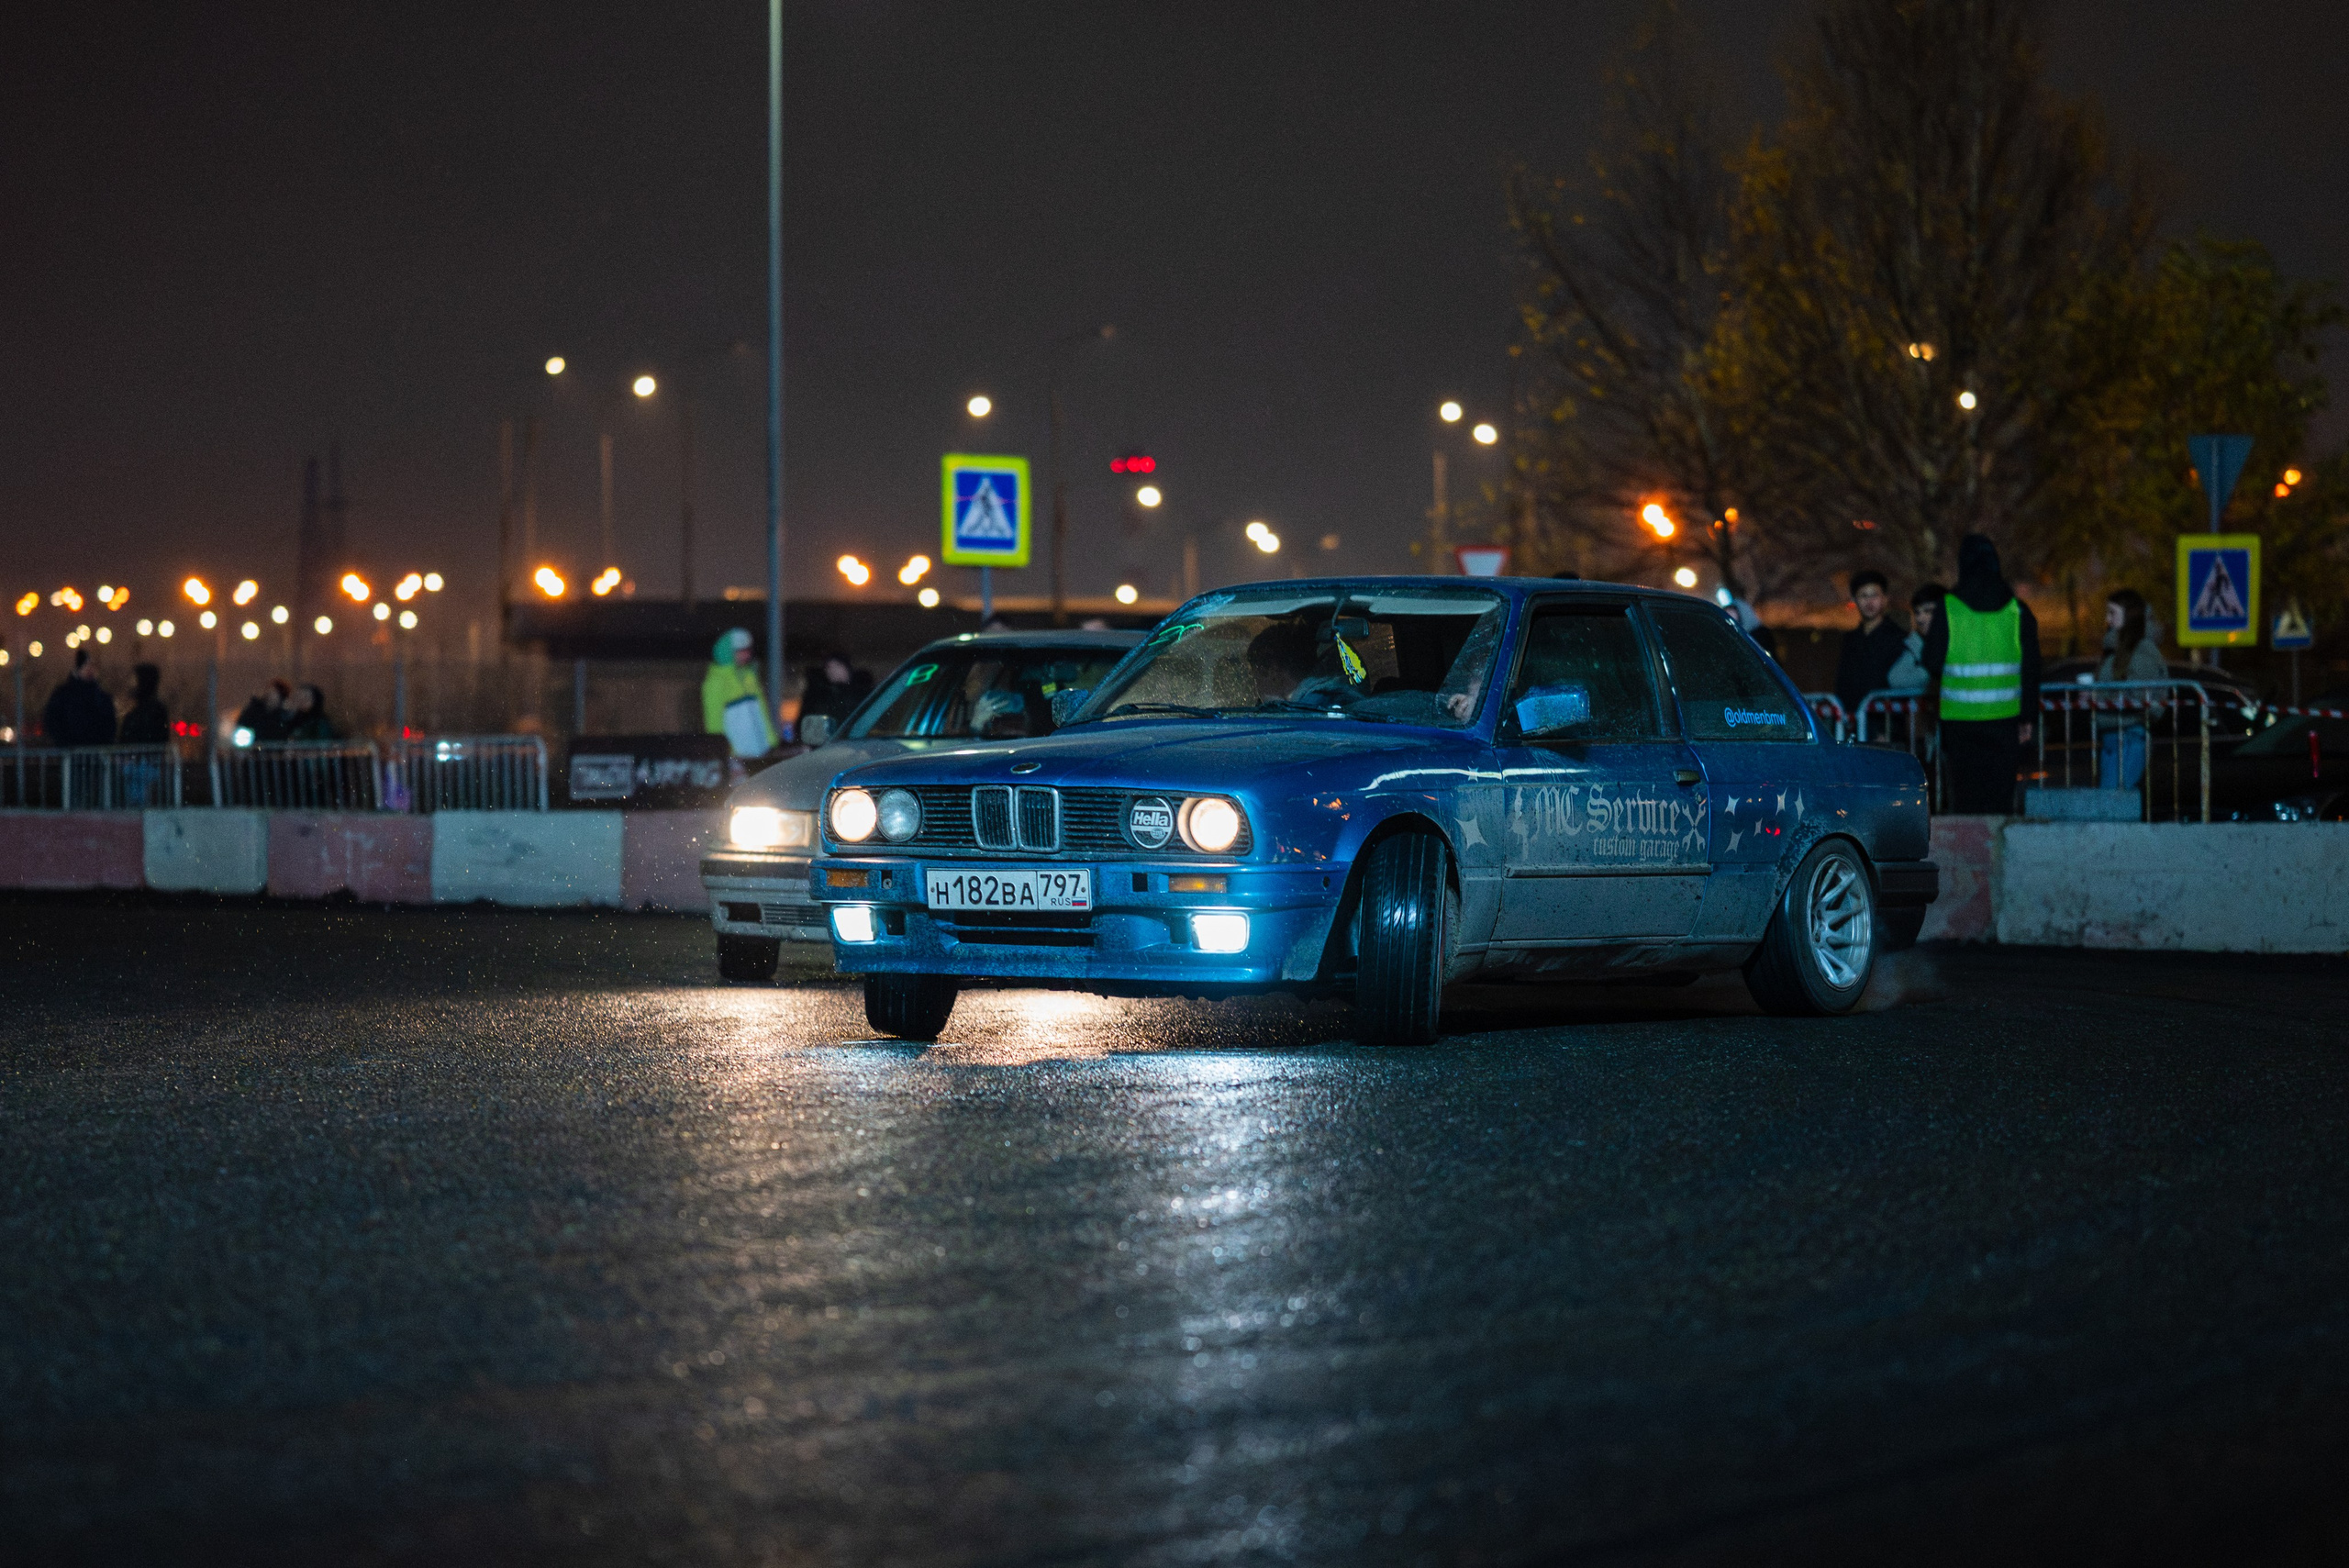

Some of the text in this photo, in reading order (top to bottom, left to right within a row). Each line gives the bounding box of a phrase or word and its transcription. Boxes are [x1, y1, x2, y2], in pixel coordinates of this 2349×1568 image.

[1724, 707, 1786, 728] @oldmenbmw
[1133, 811, 1169, 827] Hella
[1586, 783, 1681, 837] Service
[1593, 836, 1680, 862] custom garage
[1040, 873, 1081, 897] 797
[1051, 897, 1071, 906] RUS
